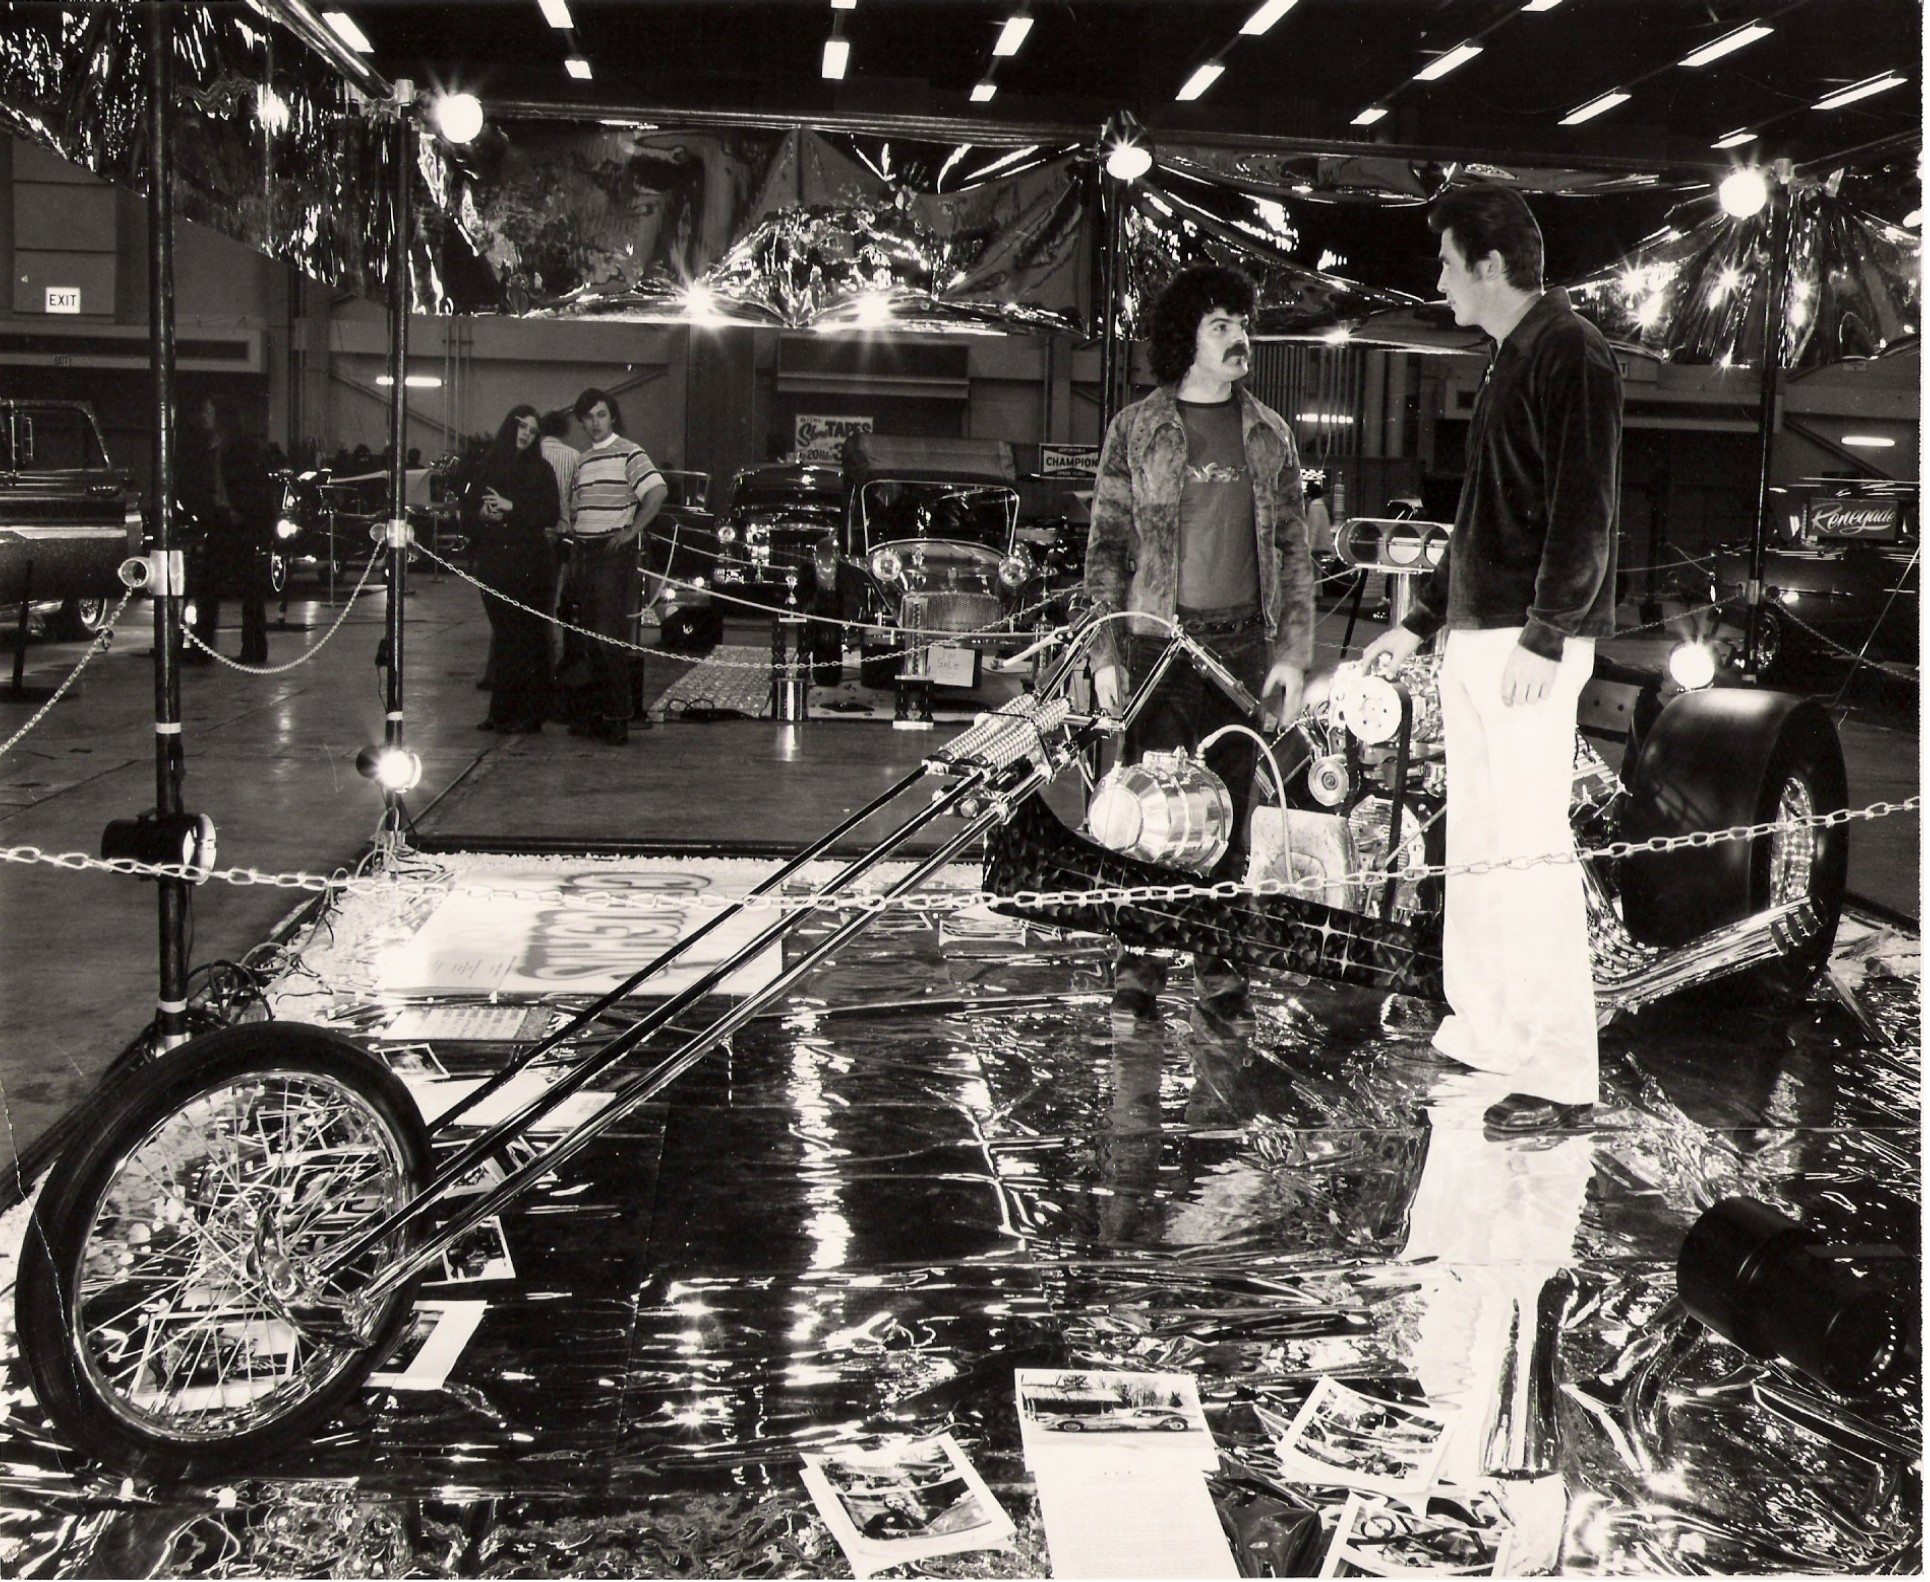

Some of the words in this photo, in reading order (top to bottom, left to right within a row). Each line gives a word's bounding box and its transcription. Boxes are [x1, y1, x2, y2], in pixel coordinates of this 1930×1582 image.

[49, 294, 77, 306] EXIT
[1046, 456, 1098, 468] CHAMPION
[1811, 502, 1896, 535] Renegade
